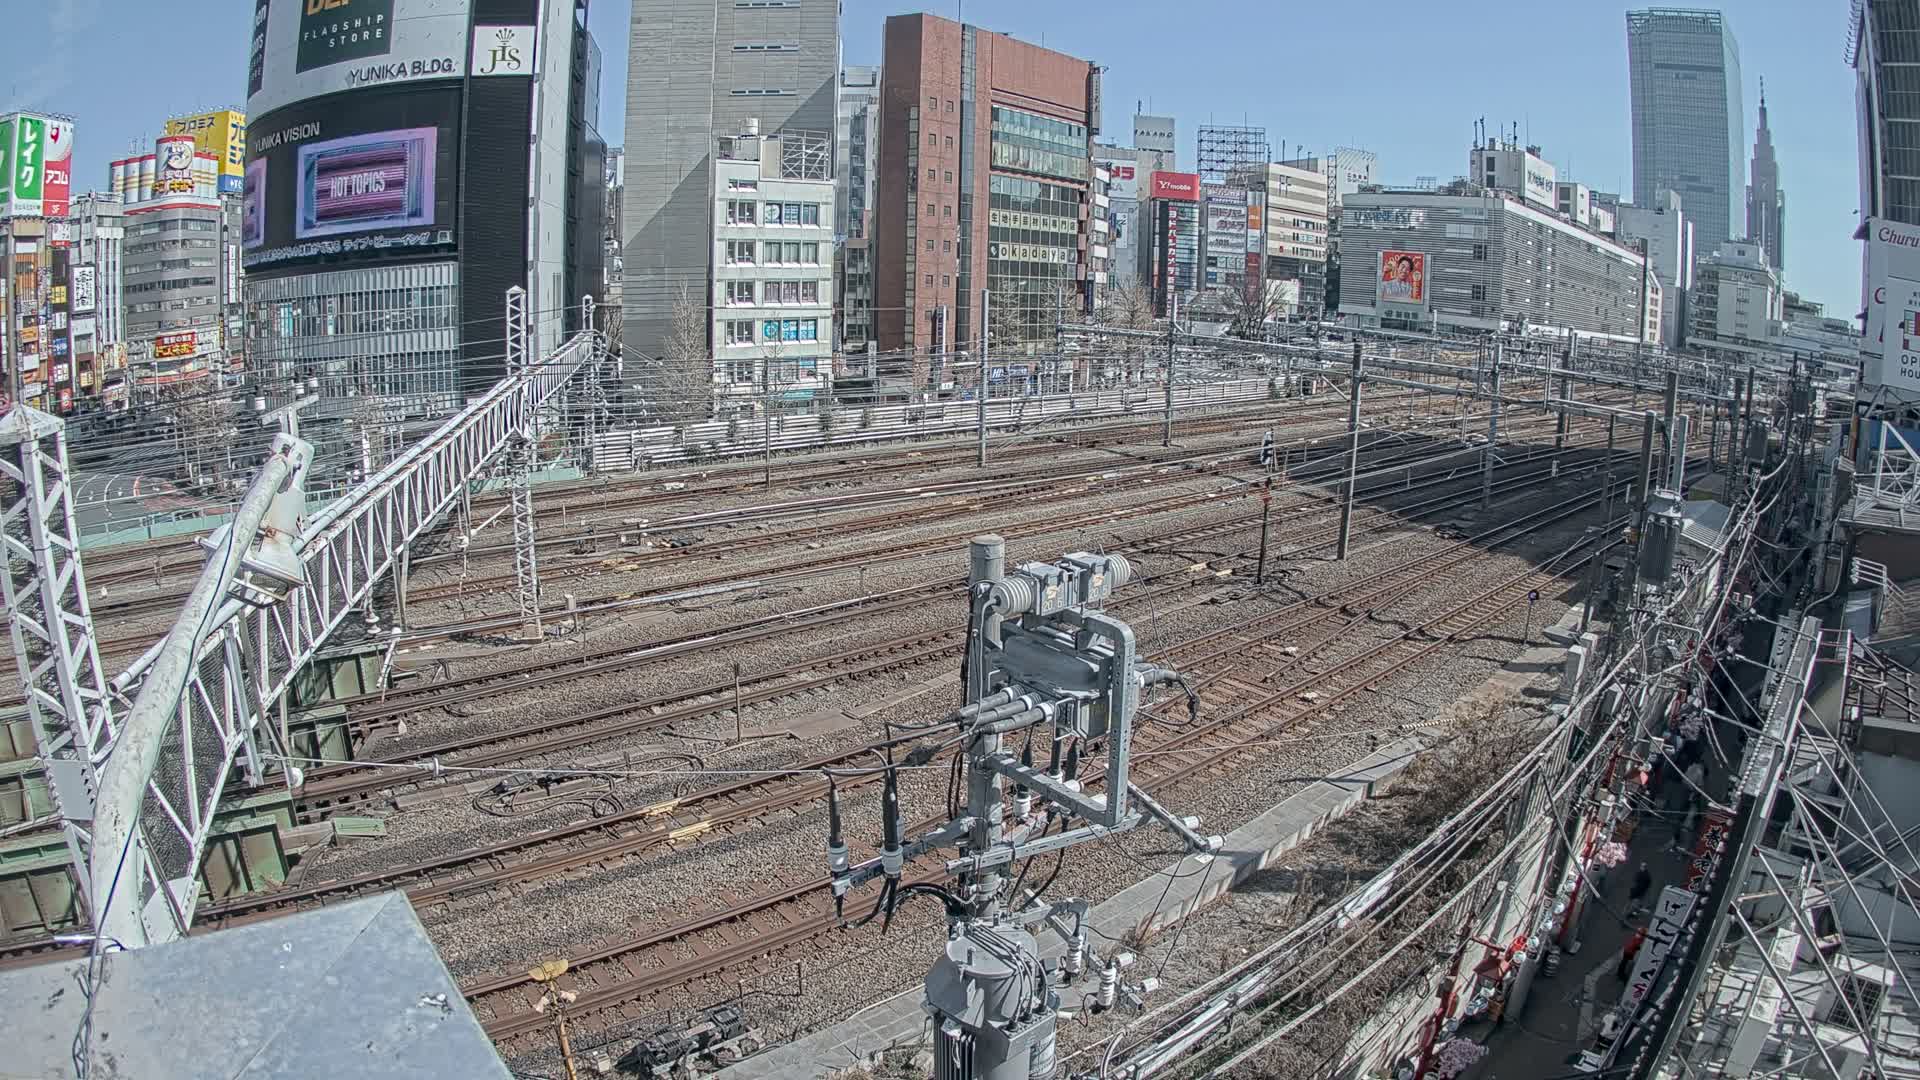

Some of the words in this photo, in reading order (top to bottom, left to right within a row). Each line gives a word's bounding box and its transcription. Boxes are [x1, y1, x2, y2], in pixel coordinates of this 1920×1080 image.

[304, 14, 384, 40] FLAGSHIP
[328, 28, 383, 47] STORE
[350, 62, 409, 84] YUNIKA
[411, 57, 457, 76] BLDG.
[176, 116, 215, 132] プロミス
[255, 131, 282, 153] YUNIKA
[282, 121, 320, 142] VISION
[21, 120, 37, 188] レイク
[45, 169, 68, 185] アコム
[330, 176, 349, 199] HOT
[351, 170, 386, 196] TOPICS
[1000, 246, 1066, 263] okadaya
[1901, 354, 1920, 368] OP
